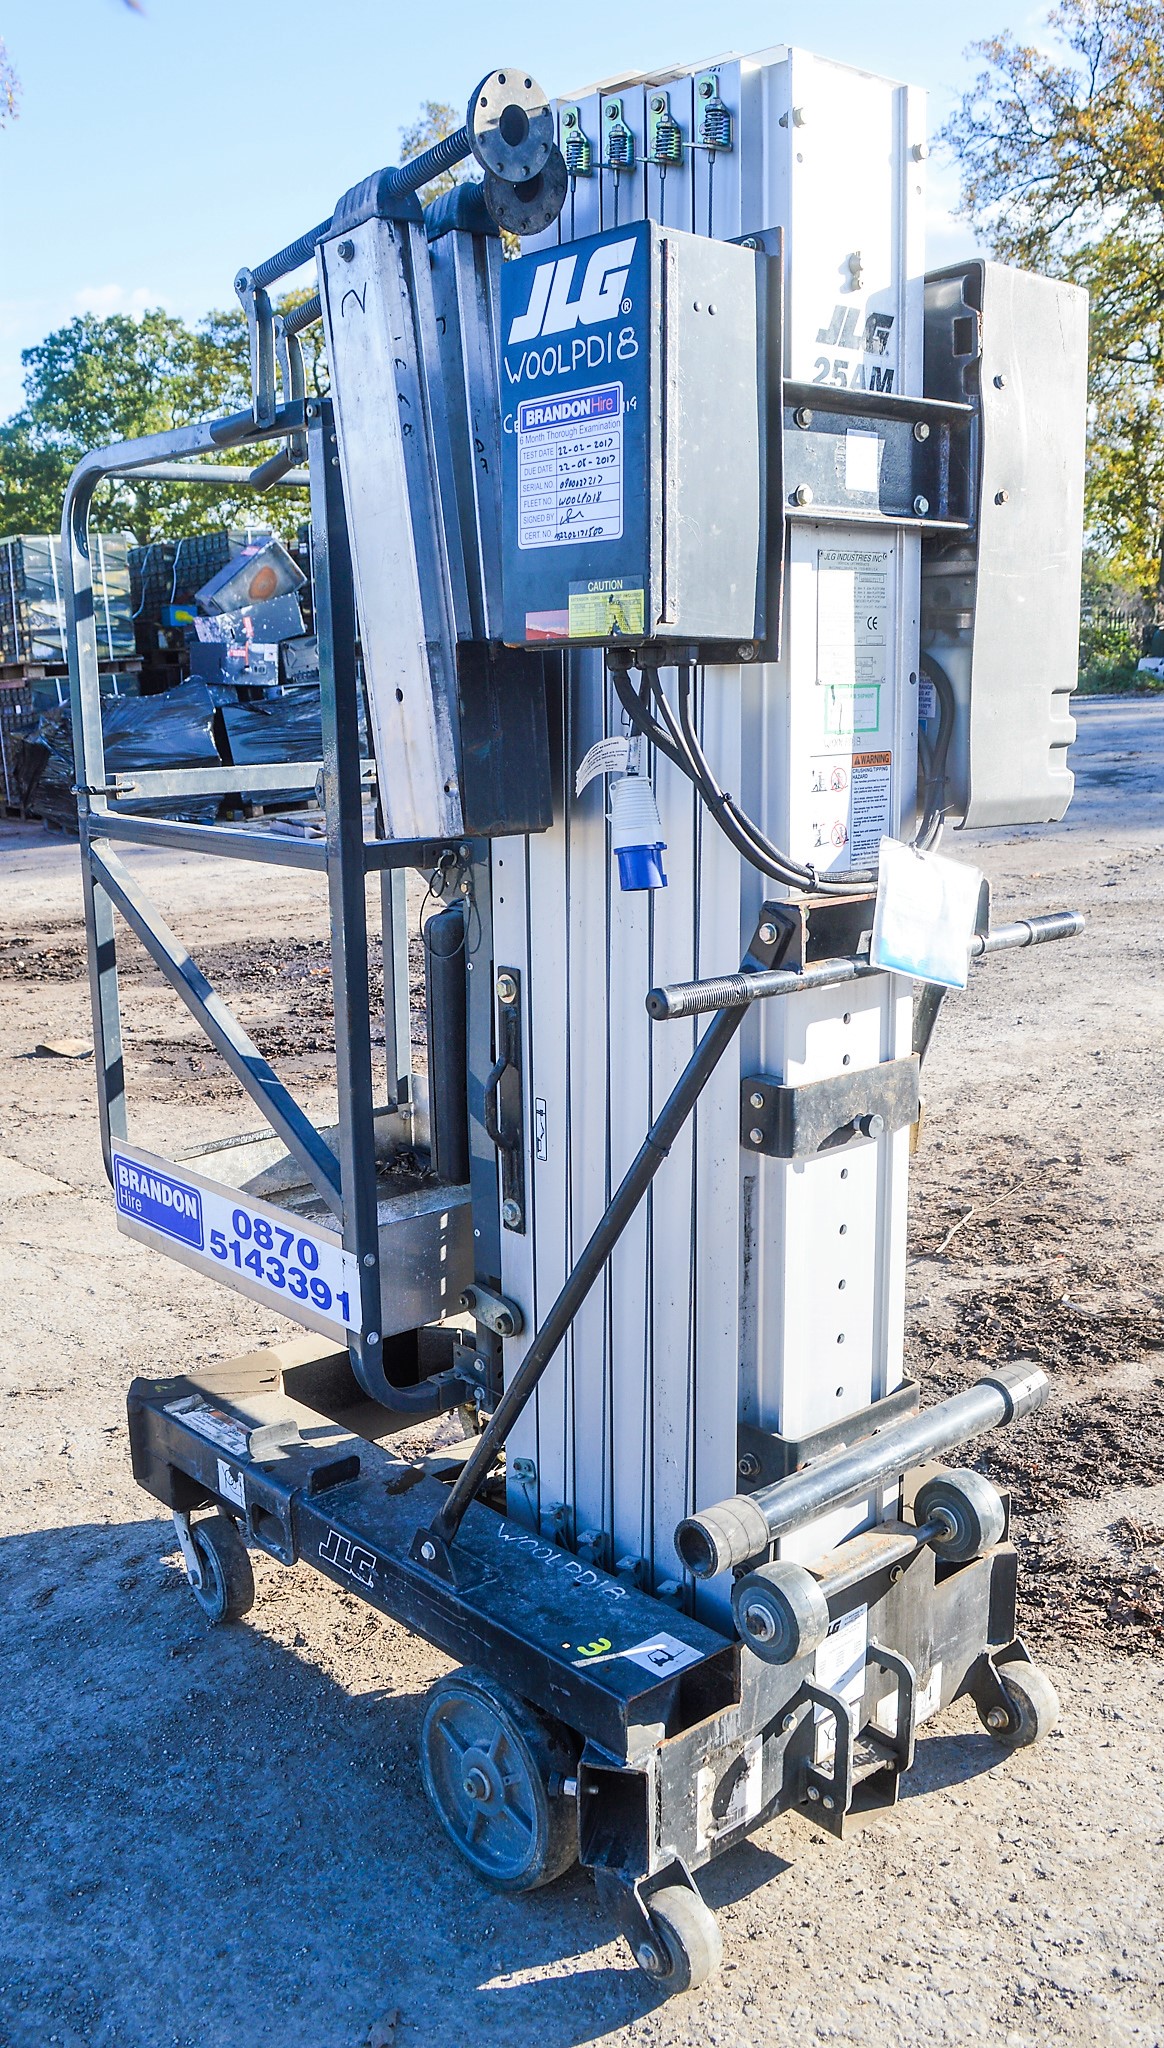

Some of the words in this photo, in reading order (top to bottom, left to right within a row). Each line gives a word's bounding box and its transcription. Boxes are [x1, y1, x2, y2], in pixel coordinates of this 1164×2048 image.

[508, 237, 637, 345] JLG
[815, 305, 895, 356] JLG
[812, 356, 895, 394] 25AM
[525, 431, 545, 444] Month
[546, 426, 577, 442] Thorough
[579, 420, 621, 435] Examination
[523, 450, 537, 460] TEST
[539, 447, 554, 458] DATE
[524, 467, 537, 476] DUE
[537, 464, 553, 474] DATE
[523, 482, 543, 492] SERIAL
[524, 499, 541, 508] FLEET
[523, 514, 545, 525] SIGNED
[546, 513, 554, 522] BY
[837, 553, 872, 562] INDUSTRIES
[588, 579, 623, 592] CAUTION
[861, 754, 890, 764] WARNING
[118, 1165, 198, 1220] BRANDON
[119, 1186, 142, 1213] Hire
[232, 1208, 319, 1271] 0870
[209, 1229, 350, 1322] 5143391
[319, 1530, 377, 1588] JLG
